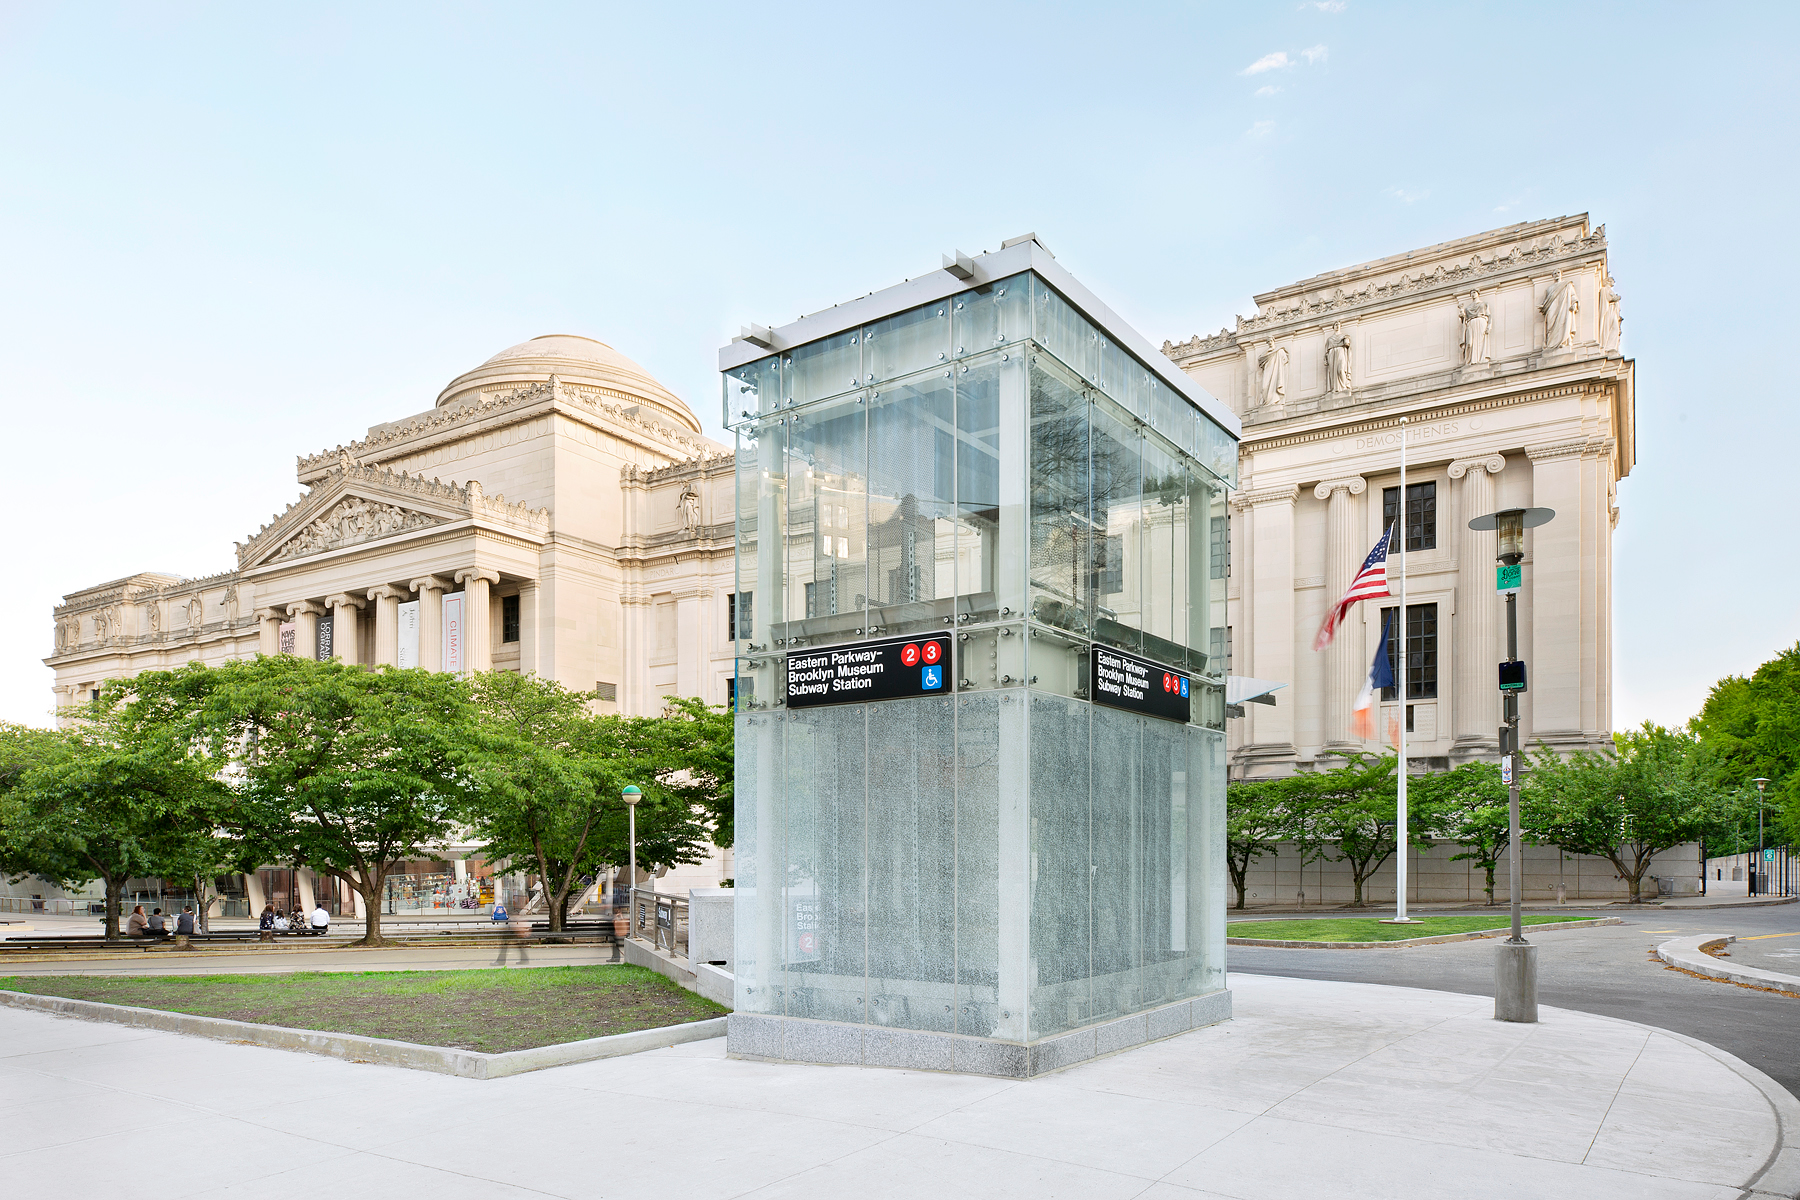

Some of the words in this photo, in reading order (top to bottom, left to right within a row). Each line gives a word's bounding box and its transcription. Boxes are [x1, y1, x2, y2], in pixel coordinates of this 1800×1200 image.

[1356, 421, 1459, 450] DEMOSTHENES
[649, 567, 675, 579] PINDAR
[906, 648, 915, 662] 2
[927, 645, 936, 660] 3
[1098, 651, 1121, 669] Eastern
[788, 657, 828, 670] Eastern
[788, 667, 834, 683] Brooklyn
[838, 663, 884, 677] Museum
[1098, 664, 1125, 684] Brooklyn
[1125, 672, 1150, 690] Museum
[788, 682, 829, 696] Subway
[832, 678, 872, 691] Station
[1098, 678, 1122, 697] Subway
[1122, 684, 1144, 700] Station
[1165, 676, 1170, 688] 2
[1173, 679, 1178, 691] 3
[804, 936, 813, 948] 2
